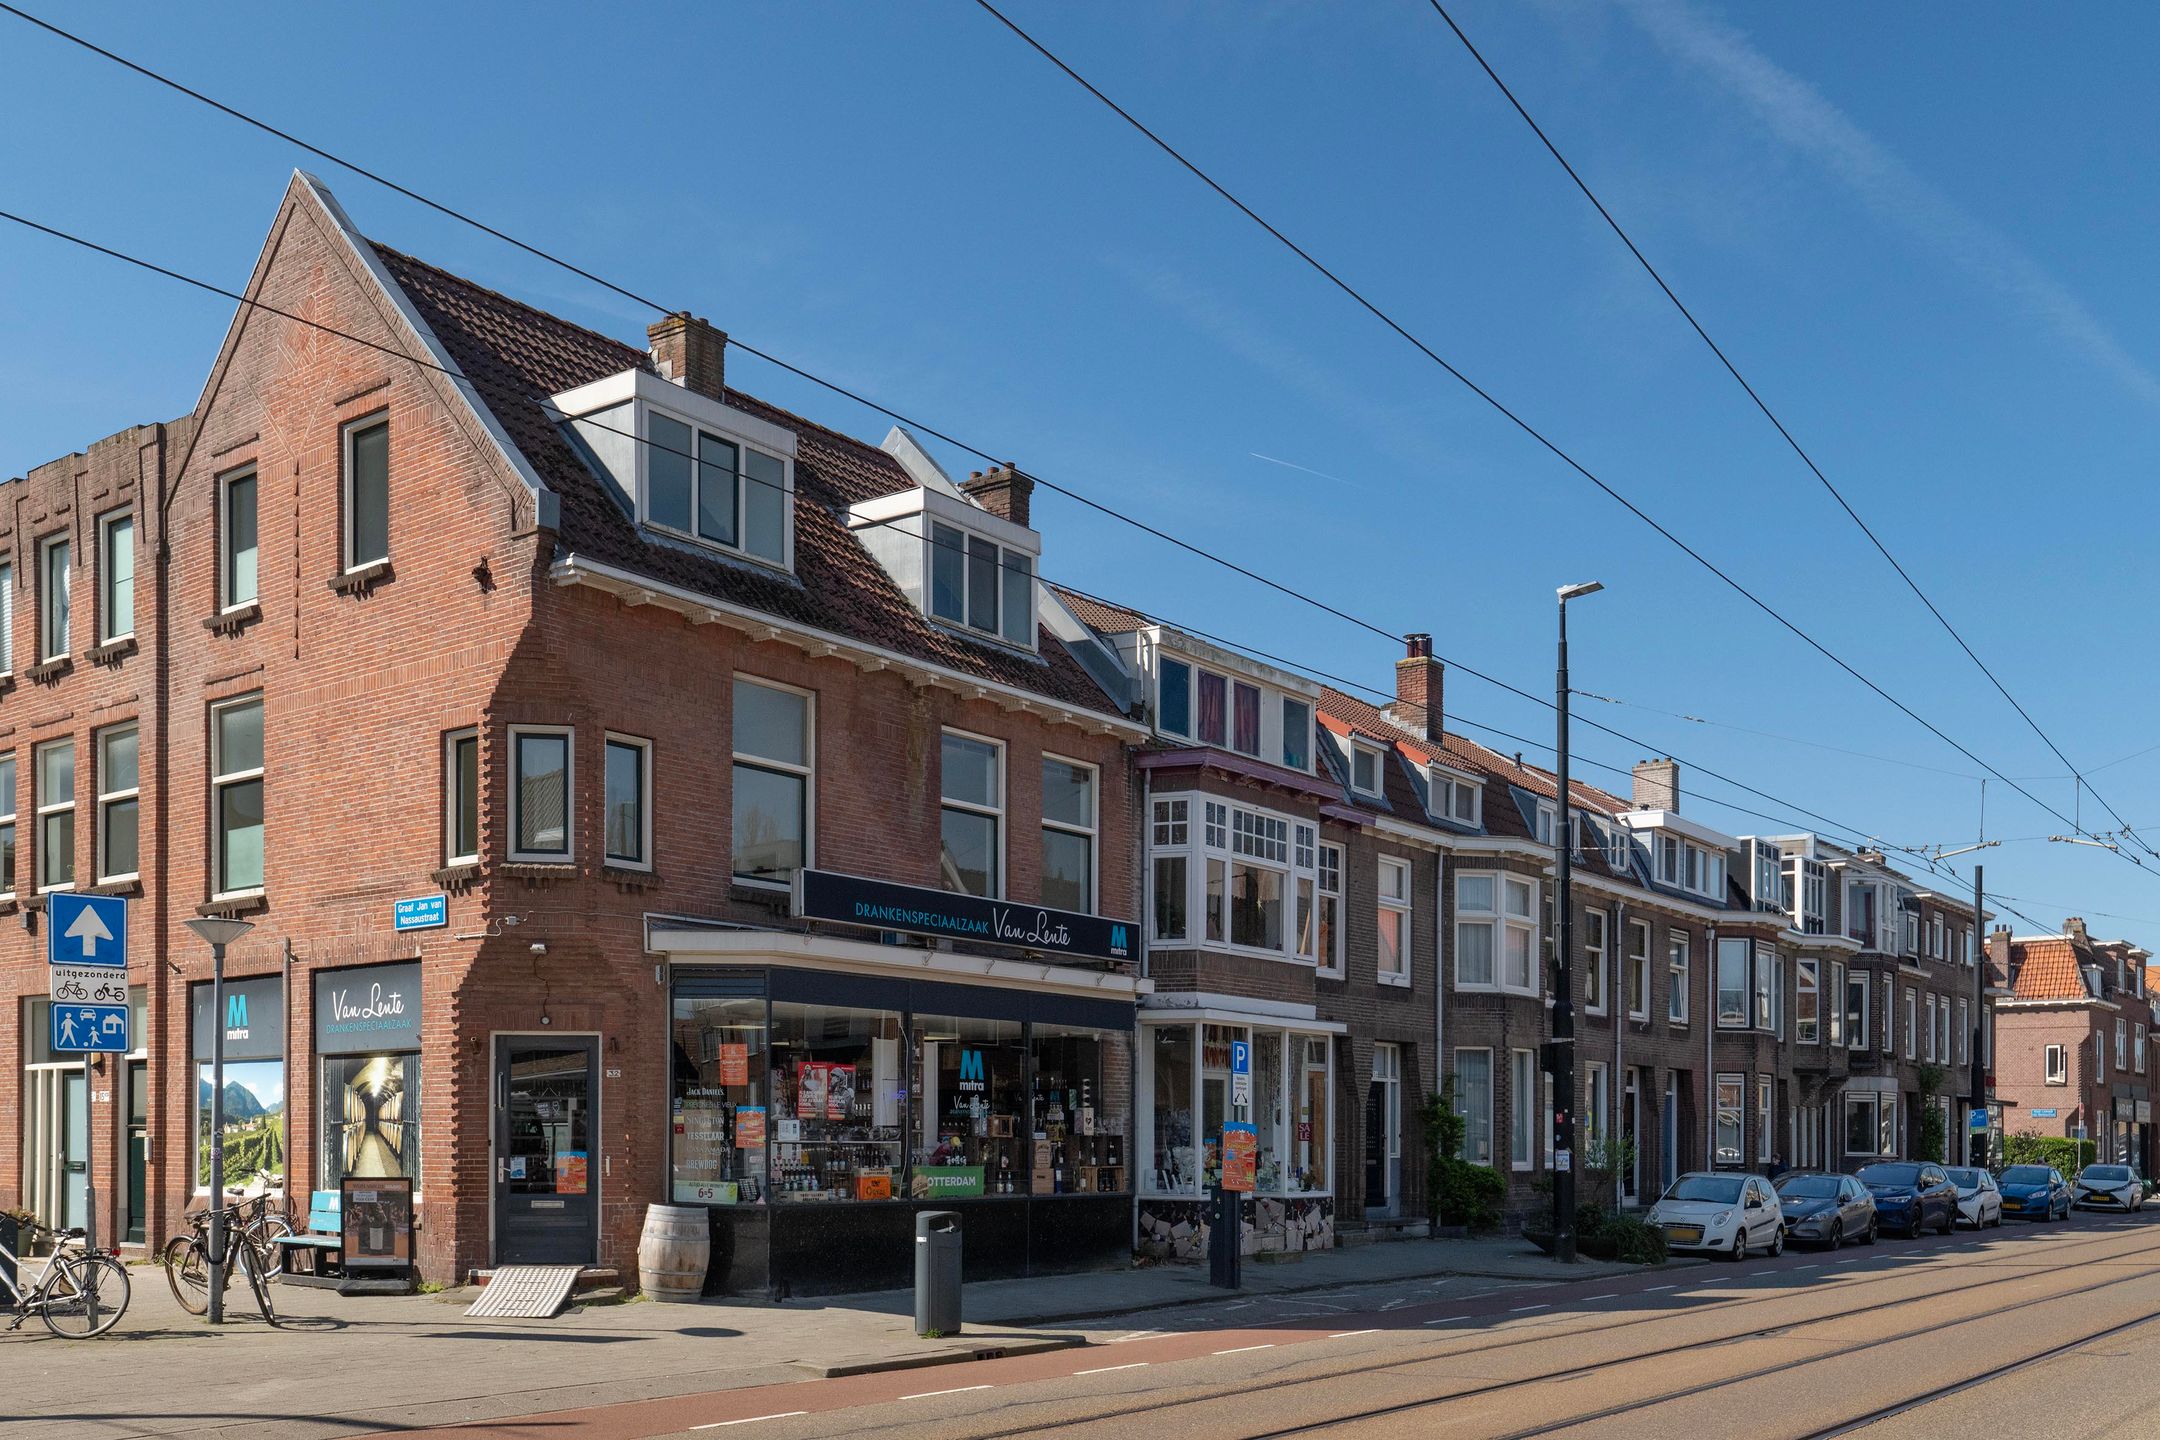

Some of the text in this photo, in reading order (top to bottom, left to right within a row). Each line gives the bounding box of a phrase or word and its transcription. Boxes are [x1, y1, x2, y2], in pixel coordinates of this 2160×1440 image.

[398, 901, 442, 913] Graaf Jan van
[400, 912, 439, 925] Nassaustraat
[855, 902, 1071, 947] DRANKENSPECIAALZAAK Van Lente
[1111, 925, 1127, 948] M
[1110, 947, 1127, 956] mitra
[56, 969, 125, 979] uitgezonderd
[333, 982, 405, 1021] Van Lente
[227, 994, 248, 1028] M
[326, 1018, 412, 1034] DRANKENSPECIAALZAAK
[227, 1028, 249, 1040] mitra
[959, 1049, 984, 1080] M
[959, 1080, 985, 1091] mitra
[953, 1094, 990, 1109] Van Lente
[687, 1131, 724, 1140] TESSELAAR
[687, 1159, 717, 1169] BREWDOG
[927, 1176, 976, 1187] OTTERDAM
